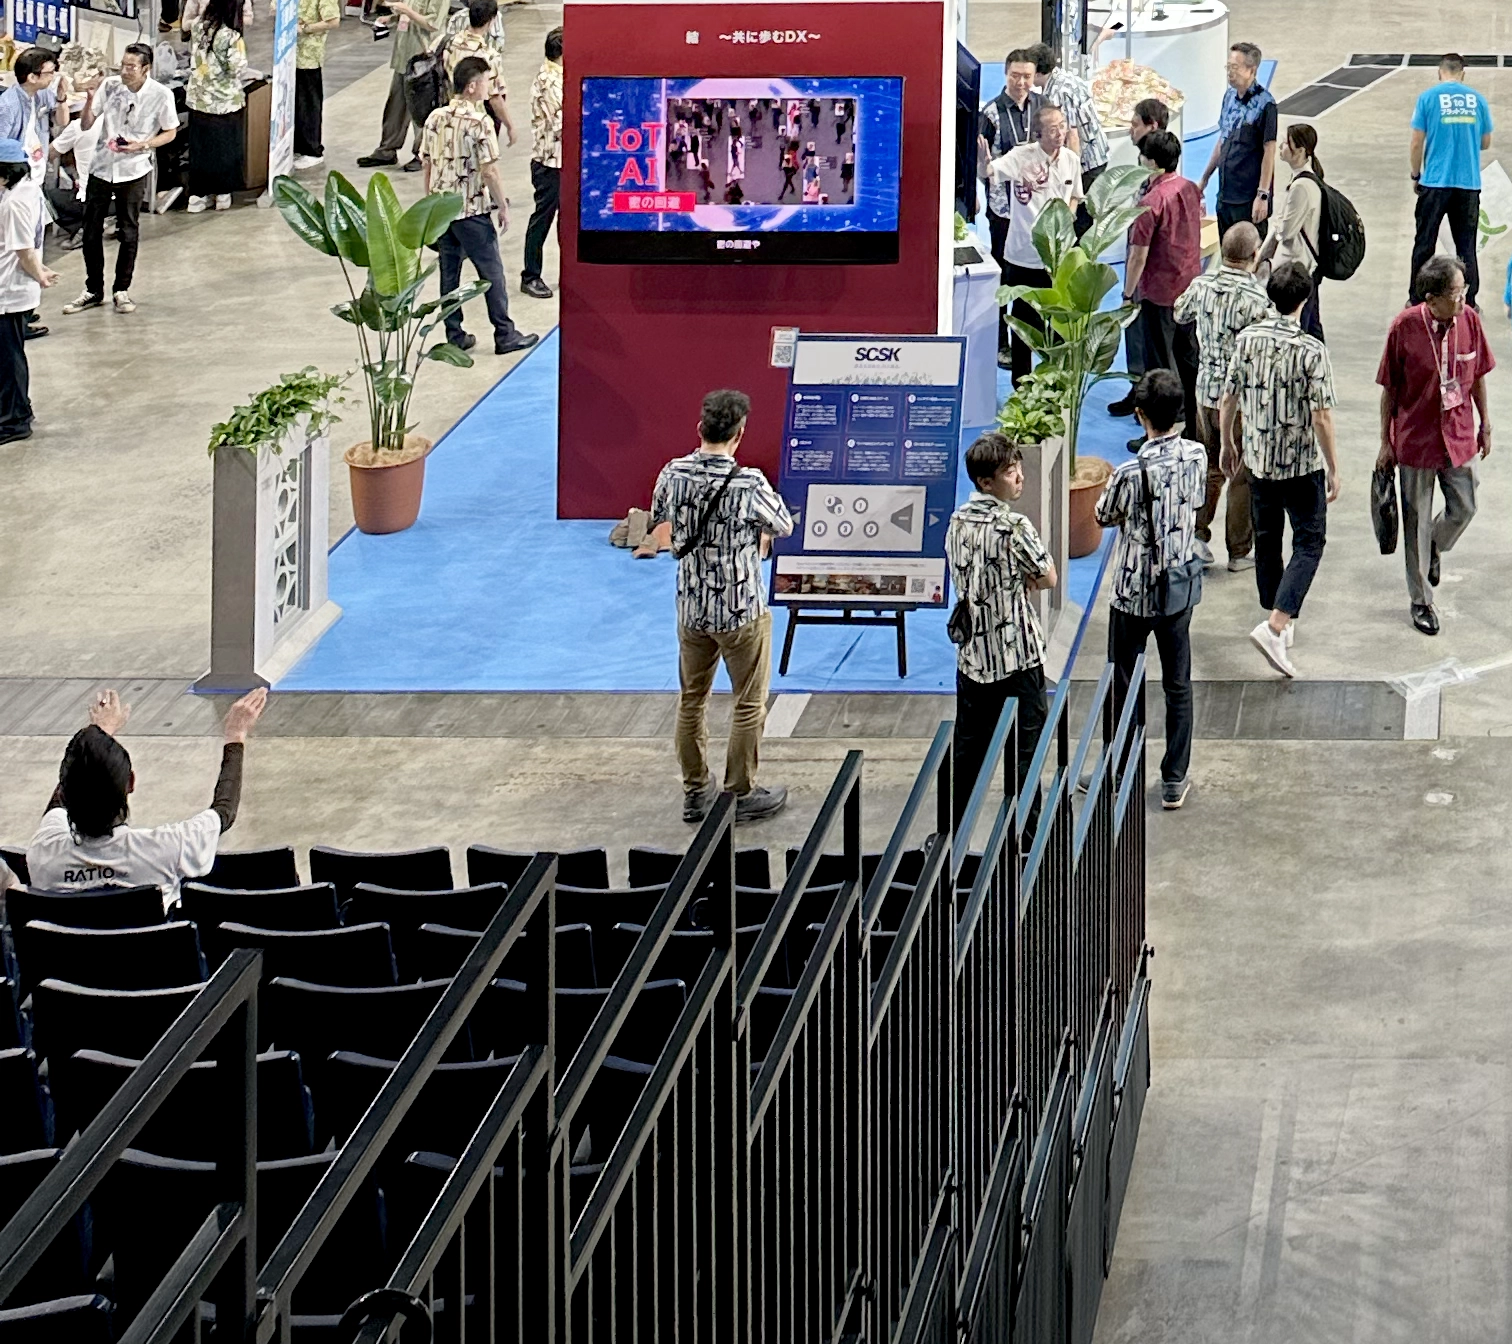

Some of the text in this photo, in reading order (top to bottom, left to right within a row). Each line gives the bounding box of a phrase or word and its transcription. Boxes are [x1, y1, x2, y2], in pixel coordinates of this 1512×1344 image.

[605, 121, 665, 152] IoT
[617, 156, 660, 187] AI
[854, 346, 902, 363] SCSK
[63, 866, 115, 883] RATIO
